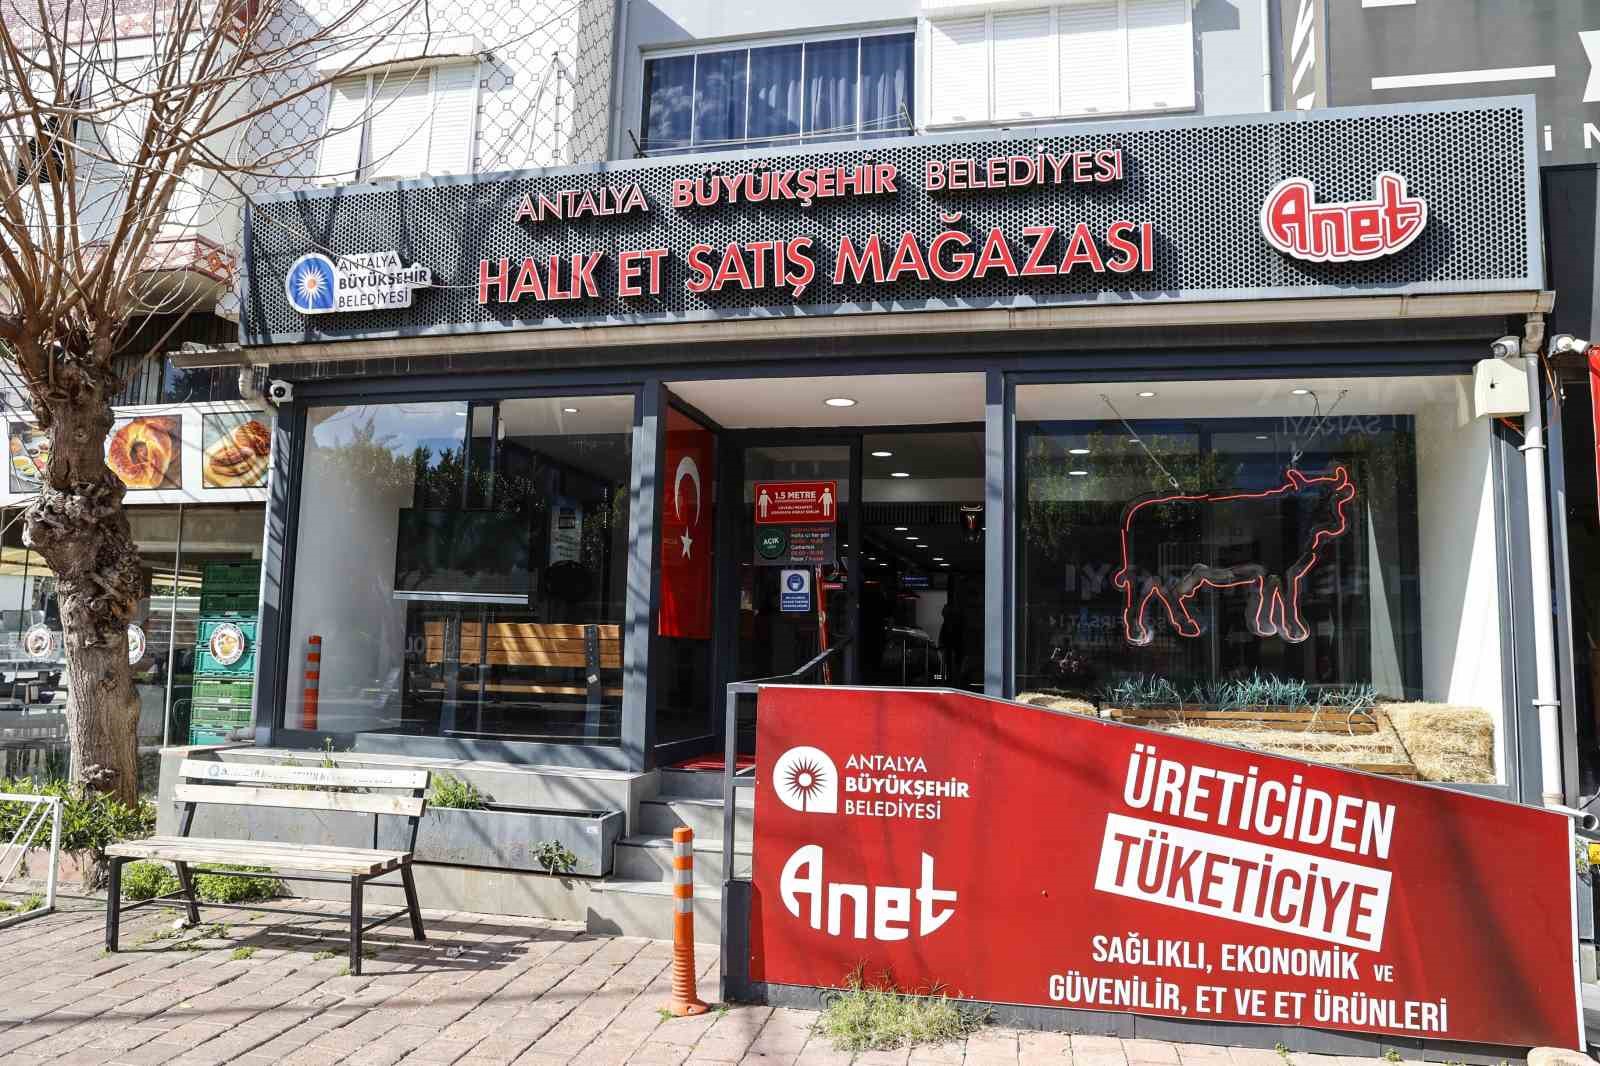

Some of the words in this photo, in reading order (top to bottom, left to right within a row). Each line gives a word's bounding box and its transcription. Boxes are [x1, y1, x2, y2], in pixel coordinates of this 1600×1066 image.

[515, 184, 649, 222] ANTALYA
[672, 154, 898, 208] BÜYÜKŞEHİR
[926, 142, 1123, 191] BELEDİYESİ
[1265, 174, 1425, 259] Anet
[339, 255, 398, 272] ANTALYA
[339, 267, 428, 289] BÜYÜKŞEHİR
[478, 251, 604, 304] HALK
[618, 248, 668, 298] ET
[686, 235, 815, 297] SATIŞ
[833, 211, 1154, 285] MAĞAZASI
[338, 289, 408, 308] BELEDİYESİ
[787, 490, 817, 500] METRE
[846, 755, 928, 773] ANTALYA
[846, 773, 970, 802] BÜYÜKŞEHİR
[846, 800, 942, 820] BELEDİYESİ
[1123, 743, 1397, 861] ÜRETİCİDEN
[780, 845, 957, 941] Anet
[1114, 831, 1379, 942] TÜKETİCİYE
[1092, 932, 1213, 973] SAĞLIKLI,
[1221, 941, 1360, 981] EKONOMİK
[1373, 965, 1394, 983] VE
[1049, 974, 1188, 1016] GÜVENİLİR,
[1196, 986, 1228, 1014] ET
[1234, 988, 1267, 1017] VE
[1274, 991, 1307, 1020] ET
[1314, 989, 1448, 1034] ÜRÜNLERİ
